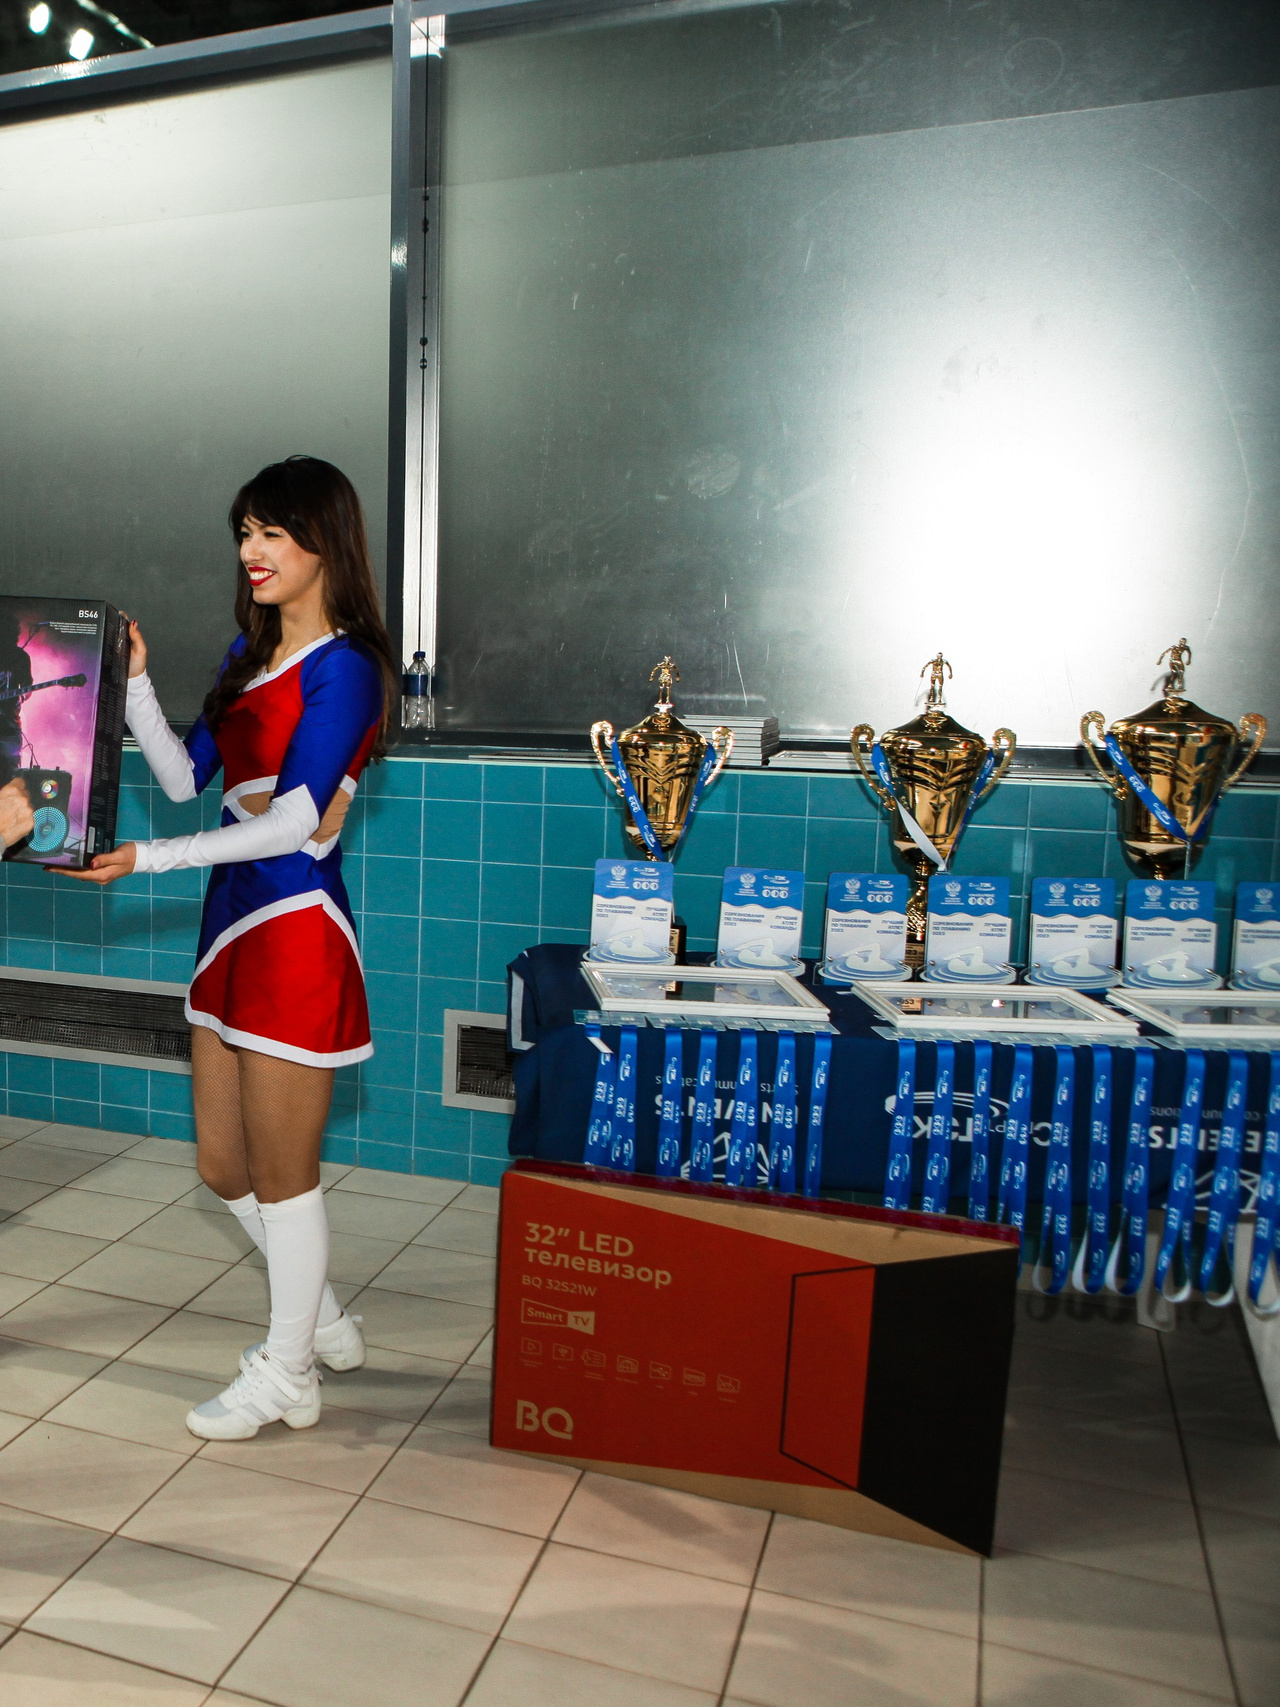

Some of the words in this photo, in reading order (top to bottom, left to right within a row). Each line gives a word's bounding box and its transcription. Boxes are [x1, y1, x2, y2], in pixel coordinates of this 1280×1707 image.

[78, 610, 99, 619] BS46
[525, 1222, 570, 1246] 32"
[578, 1230, 634, 1257] LED
[524, 1247, 673, 1289] телевизор
[521, 1274, 542, 1289] BQ
[545, 1279, 597, 1297] 32S21W
[527, 1307, 563, 1323] Smart
[572, 1315, 590, 1326] TV
[515, 1399, 573, 1440] BQ
